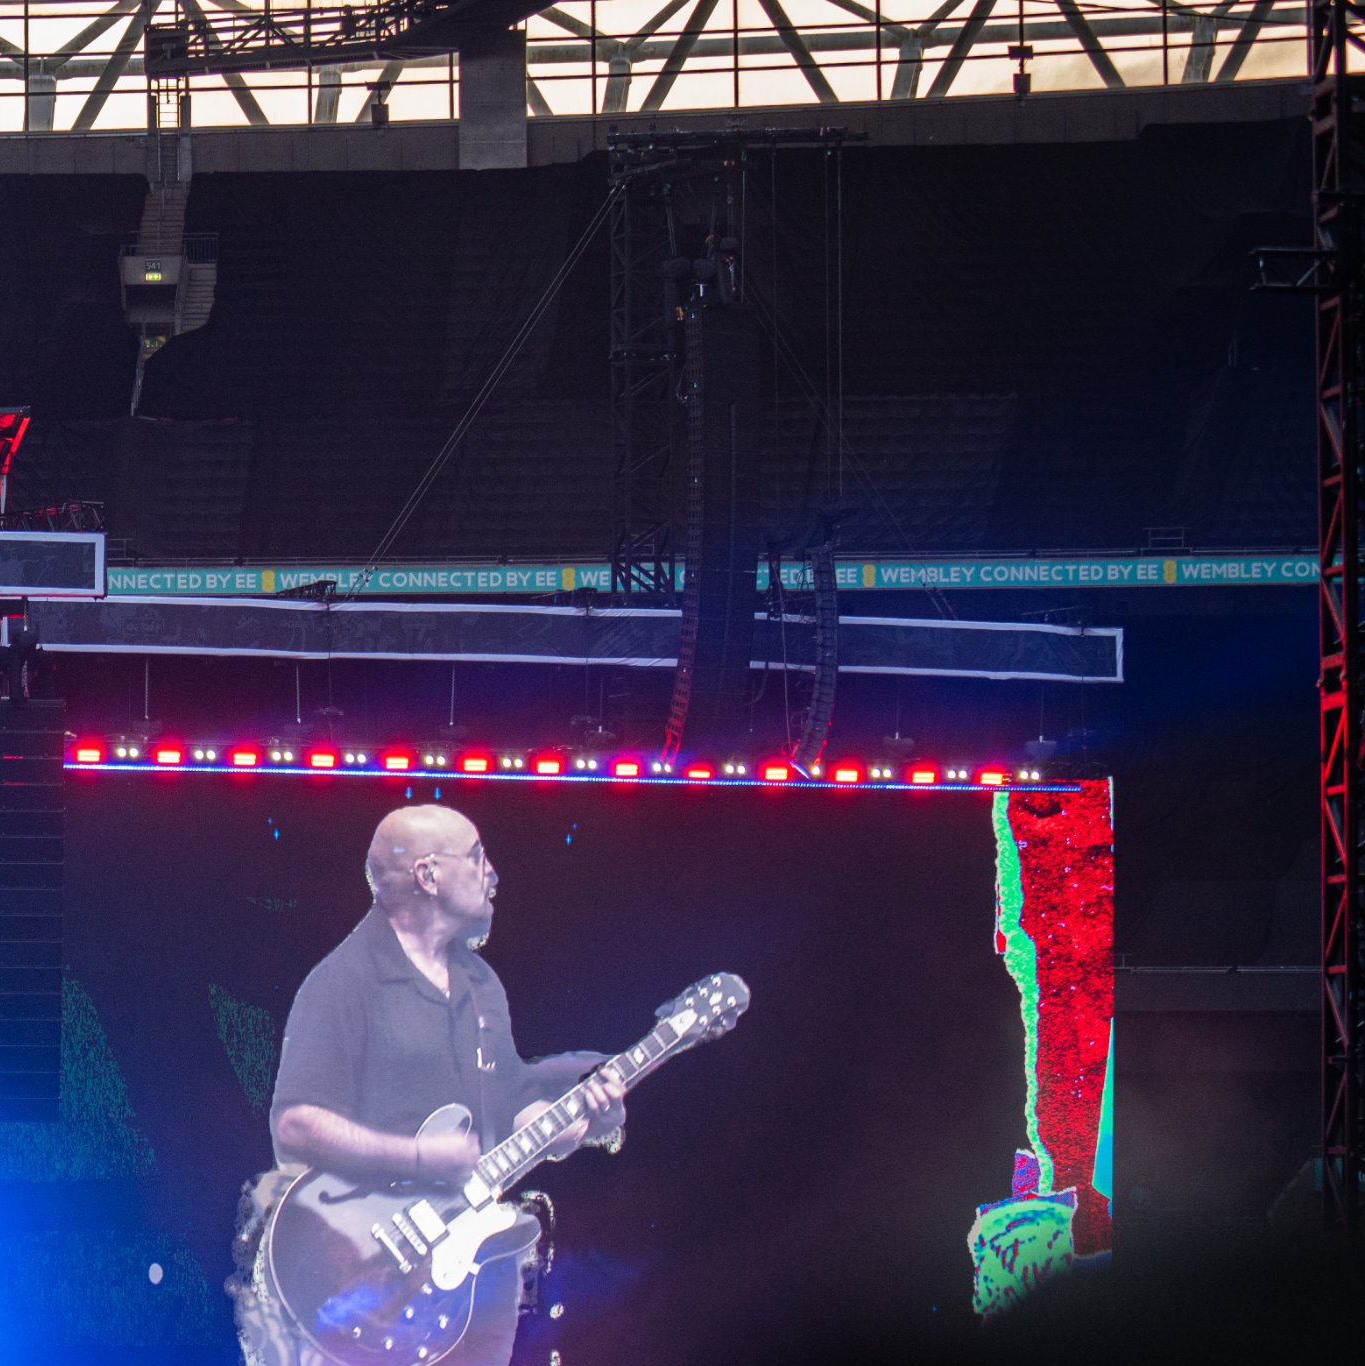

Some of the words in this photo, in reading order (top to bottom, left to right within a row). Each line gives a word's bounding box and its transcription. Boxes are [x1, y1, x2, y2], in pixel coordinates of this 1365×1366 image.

[146, 262, 161, 270] 541
[880, 566, 975, 583] WEMBLEY
[980, 564, 1103, 582] CONNECTED
[1107, 564, 1132, 580] BY
[1137, 564, 1158, 580] EE
[1181, 561, 1276, 579] WEMBLEY
[109, 573, 201, 590] NNECTED
[206, 574, 232, 590] BY
[236, 573, 257, 589] EE
[379, 571, 501, 588] CONNECTED
[506, 572, 531, 588] BY
[535, 572, 557, 588] EE
